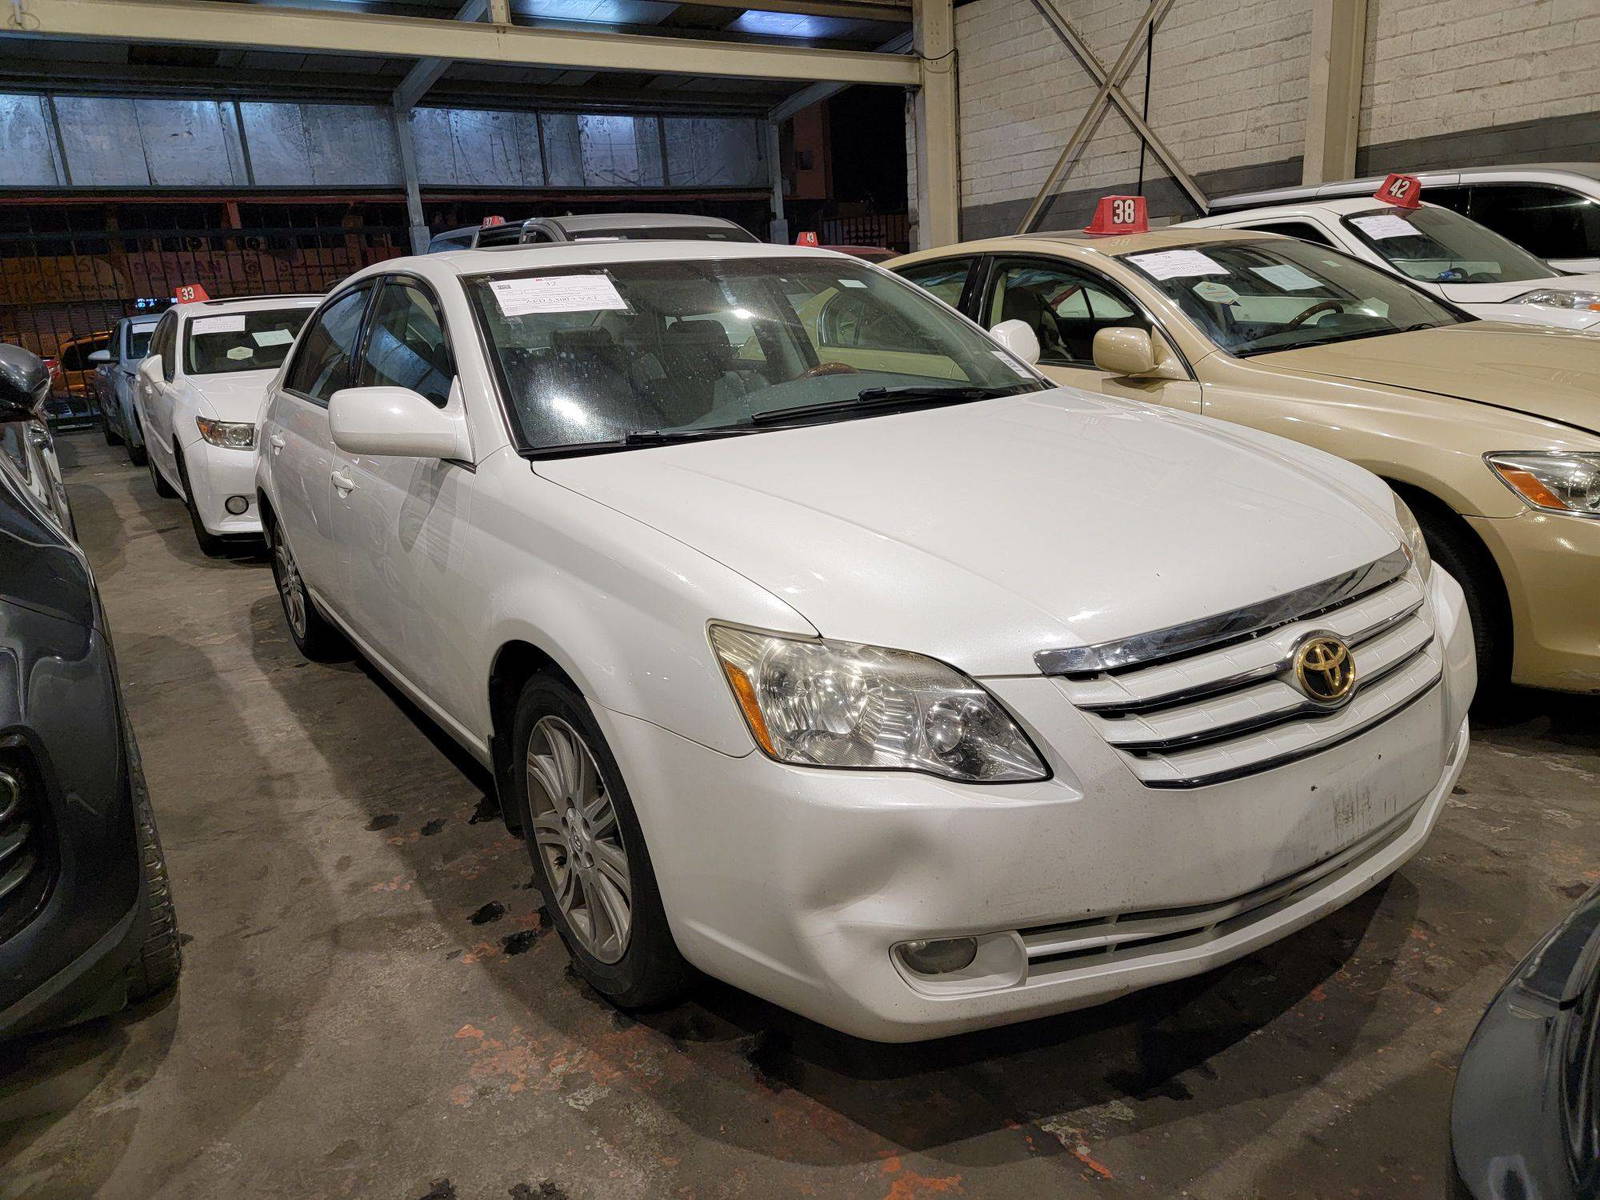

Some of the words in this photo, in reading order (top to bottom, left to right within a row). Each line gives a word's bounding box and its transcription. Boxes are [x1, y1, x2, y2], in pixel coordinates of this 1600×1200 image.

[1390, 178, 1411, 198] 42
[1113, 199, 1135, 224] 38
[181, 286, 195, 301] 33
